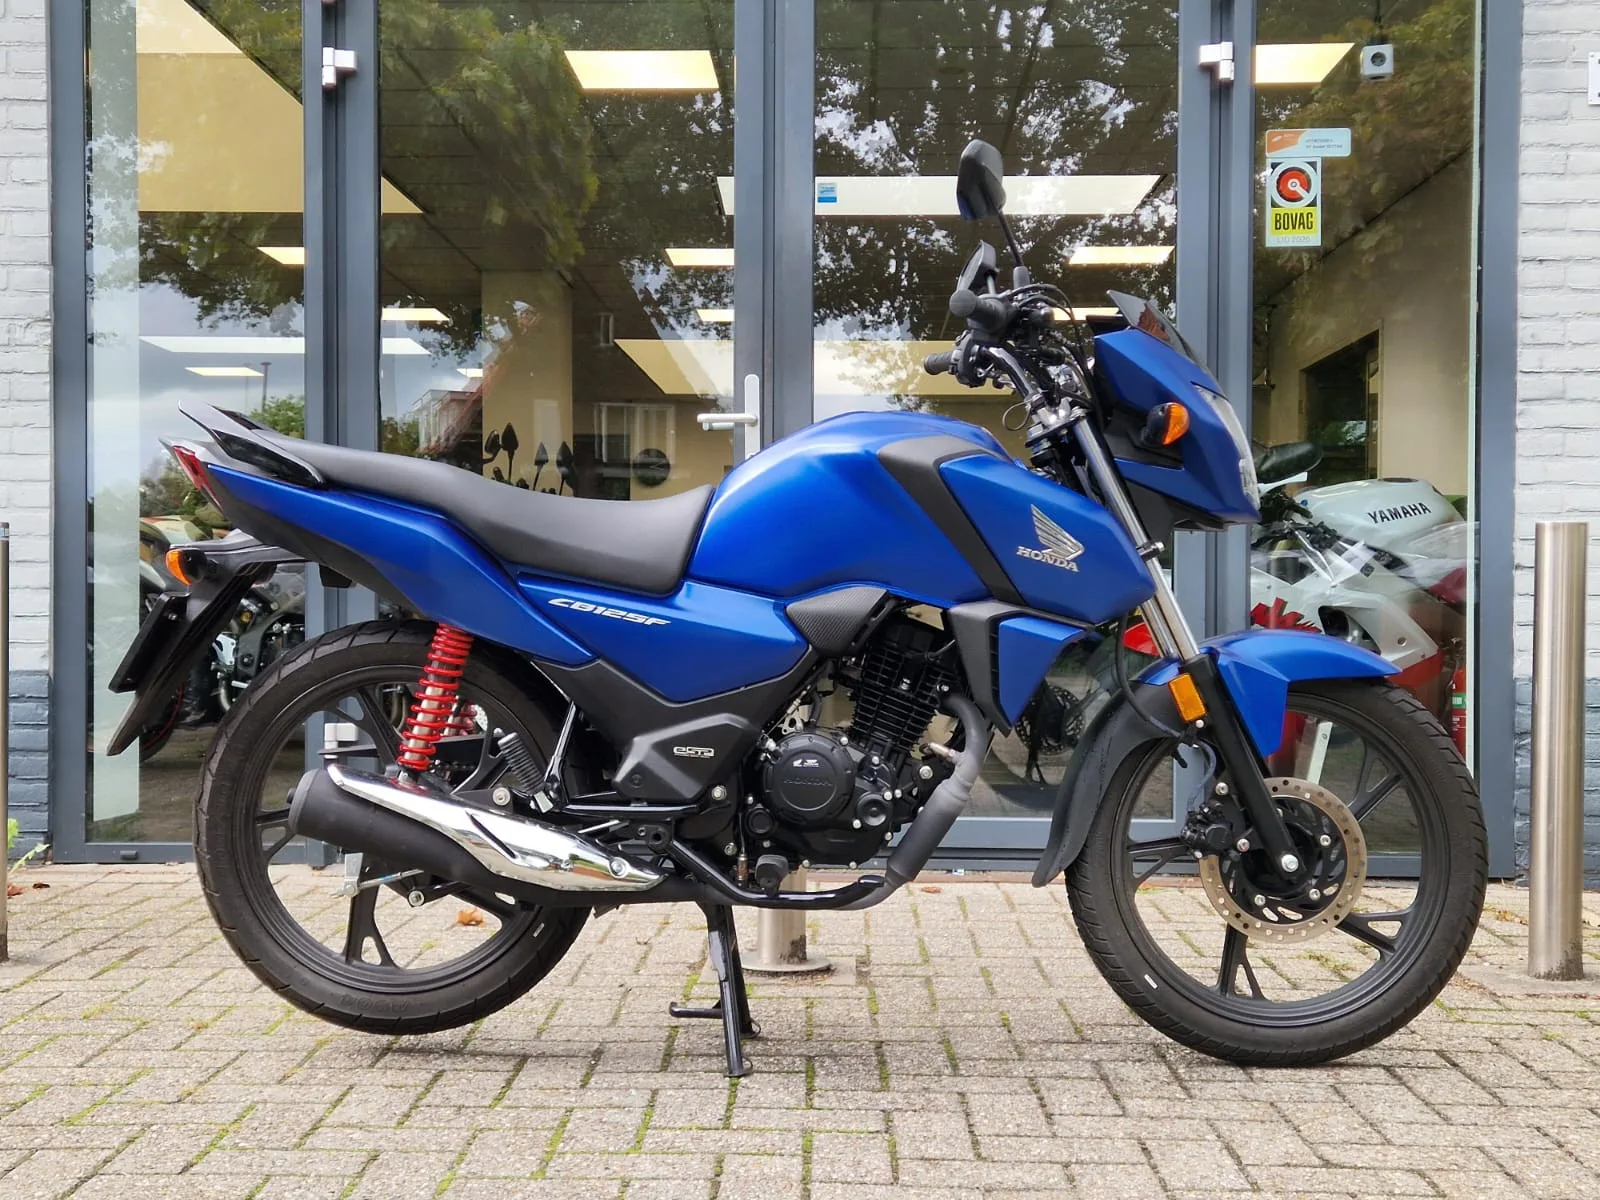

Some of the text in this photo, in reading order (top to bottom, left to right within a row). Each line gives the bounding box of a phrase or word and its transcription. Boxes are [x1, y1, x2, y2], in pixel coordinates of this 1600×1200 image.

[1274, 212, 1314, 231] BOVAG
[1367, 502, 1432, 524] YAMAHA
[1016, 545, 1079, 573] HONDA
[548, 598, 672, 625] CB125F
